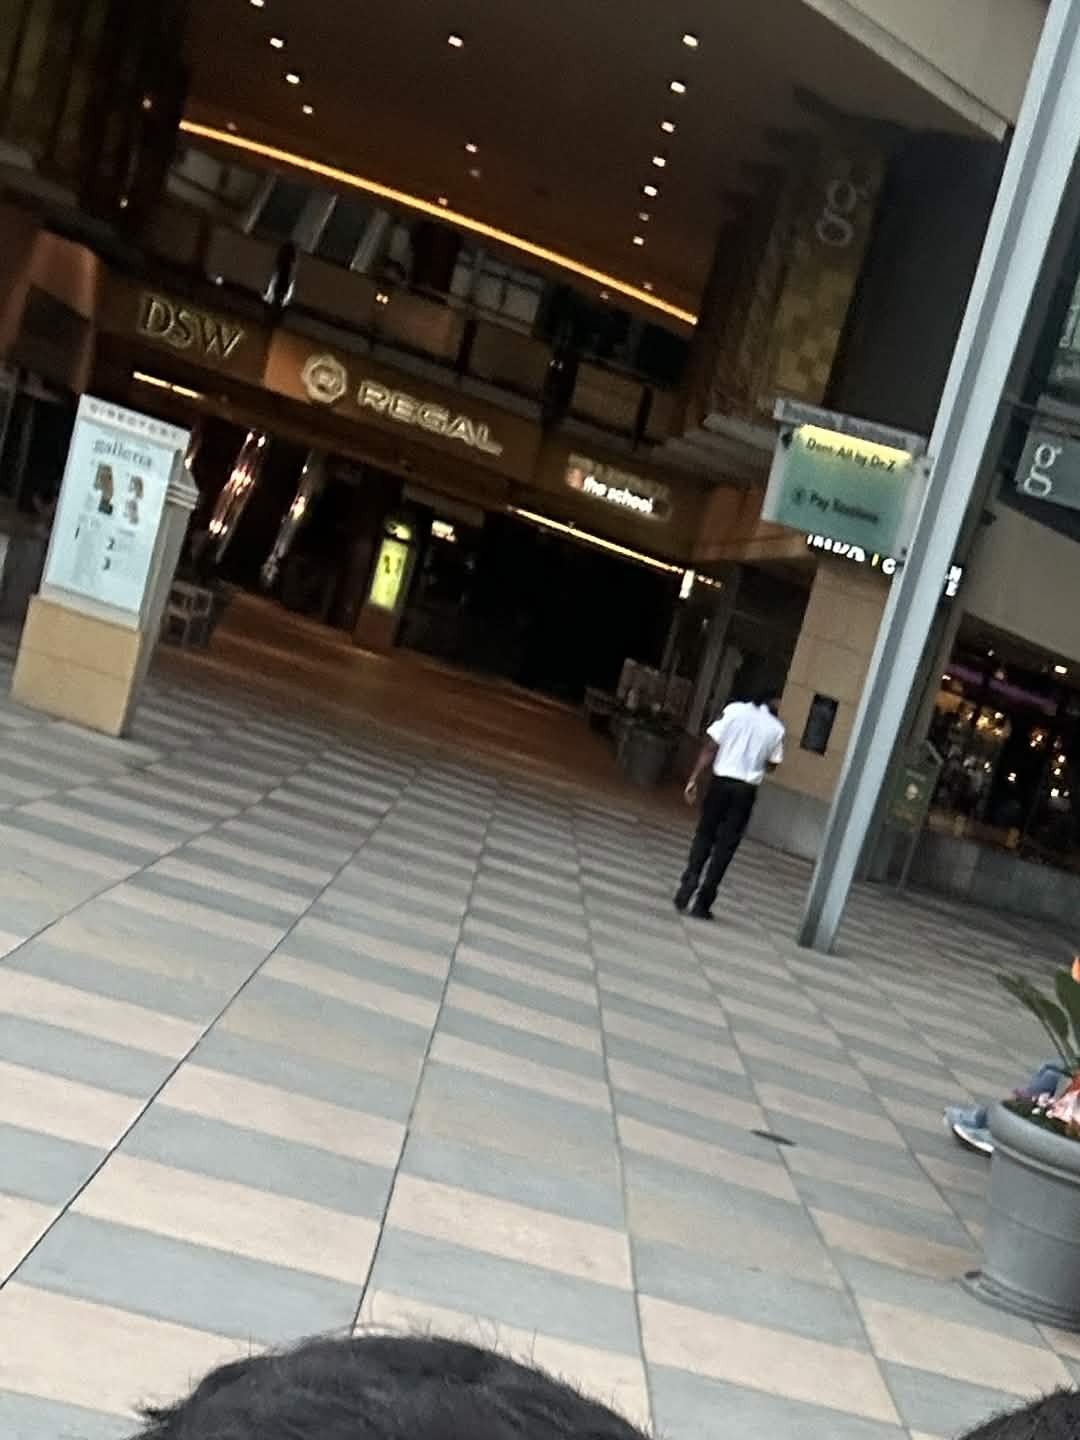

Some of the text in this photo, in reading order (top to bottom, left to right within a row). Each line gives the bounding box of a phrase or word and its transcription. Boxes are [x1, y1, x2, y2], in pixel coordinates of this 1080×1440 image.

[138, 293, 245, 359] DSW
[357, 379, 504, 456] REGAL
[1023, 443, 1063, 496] g
